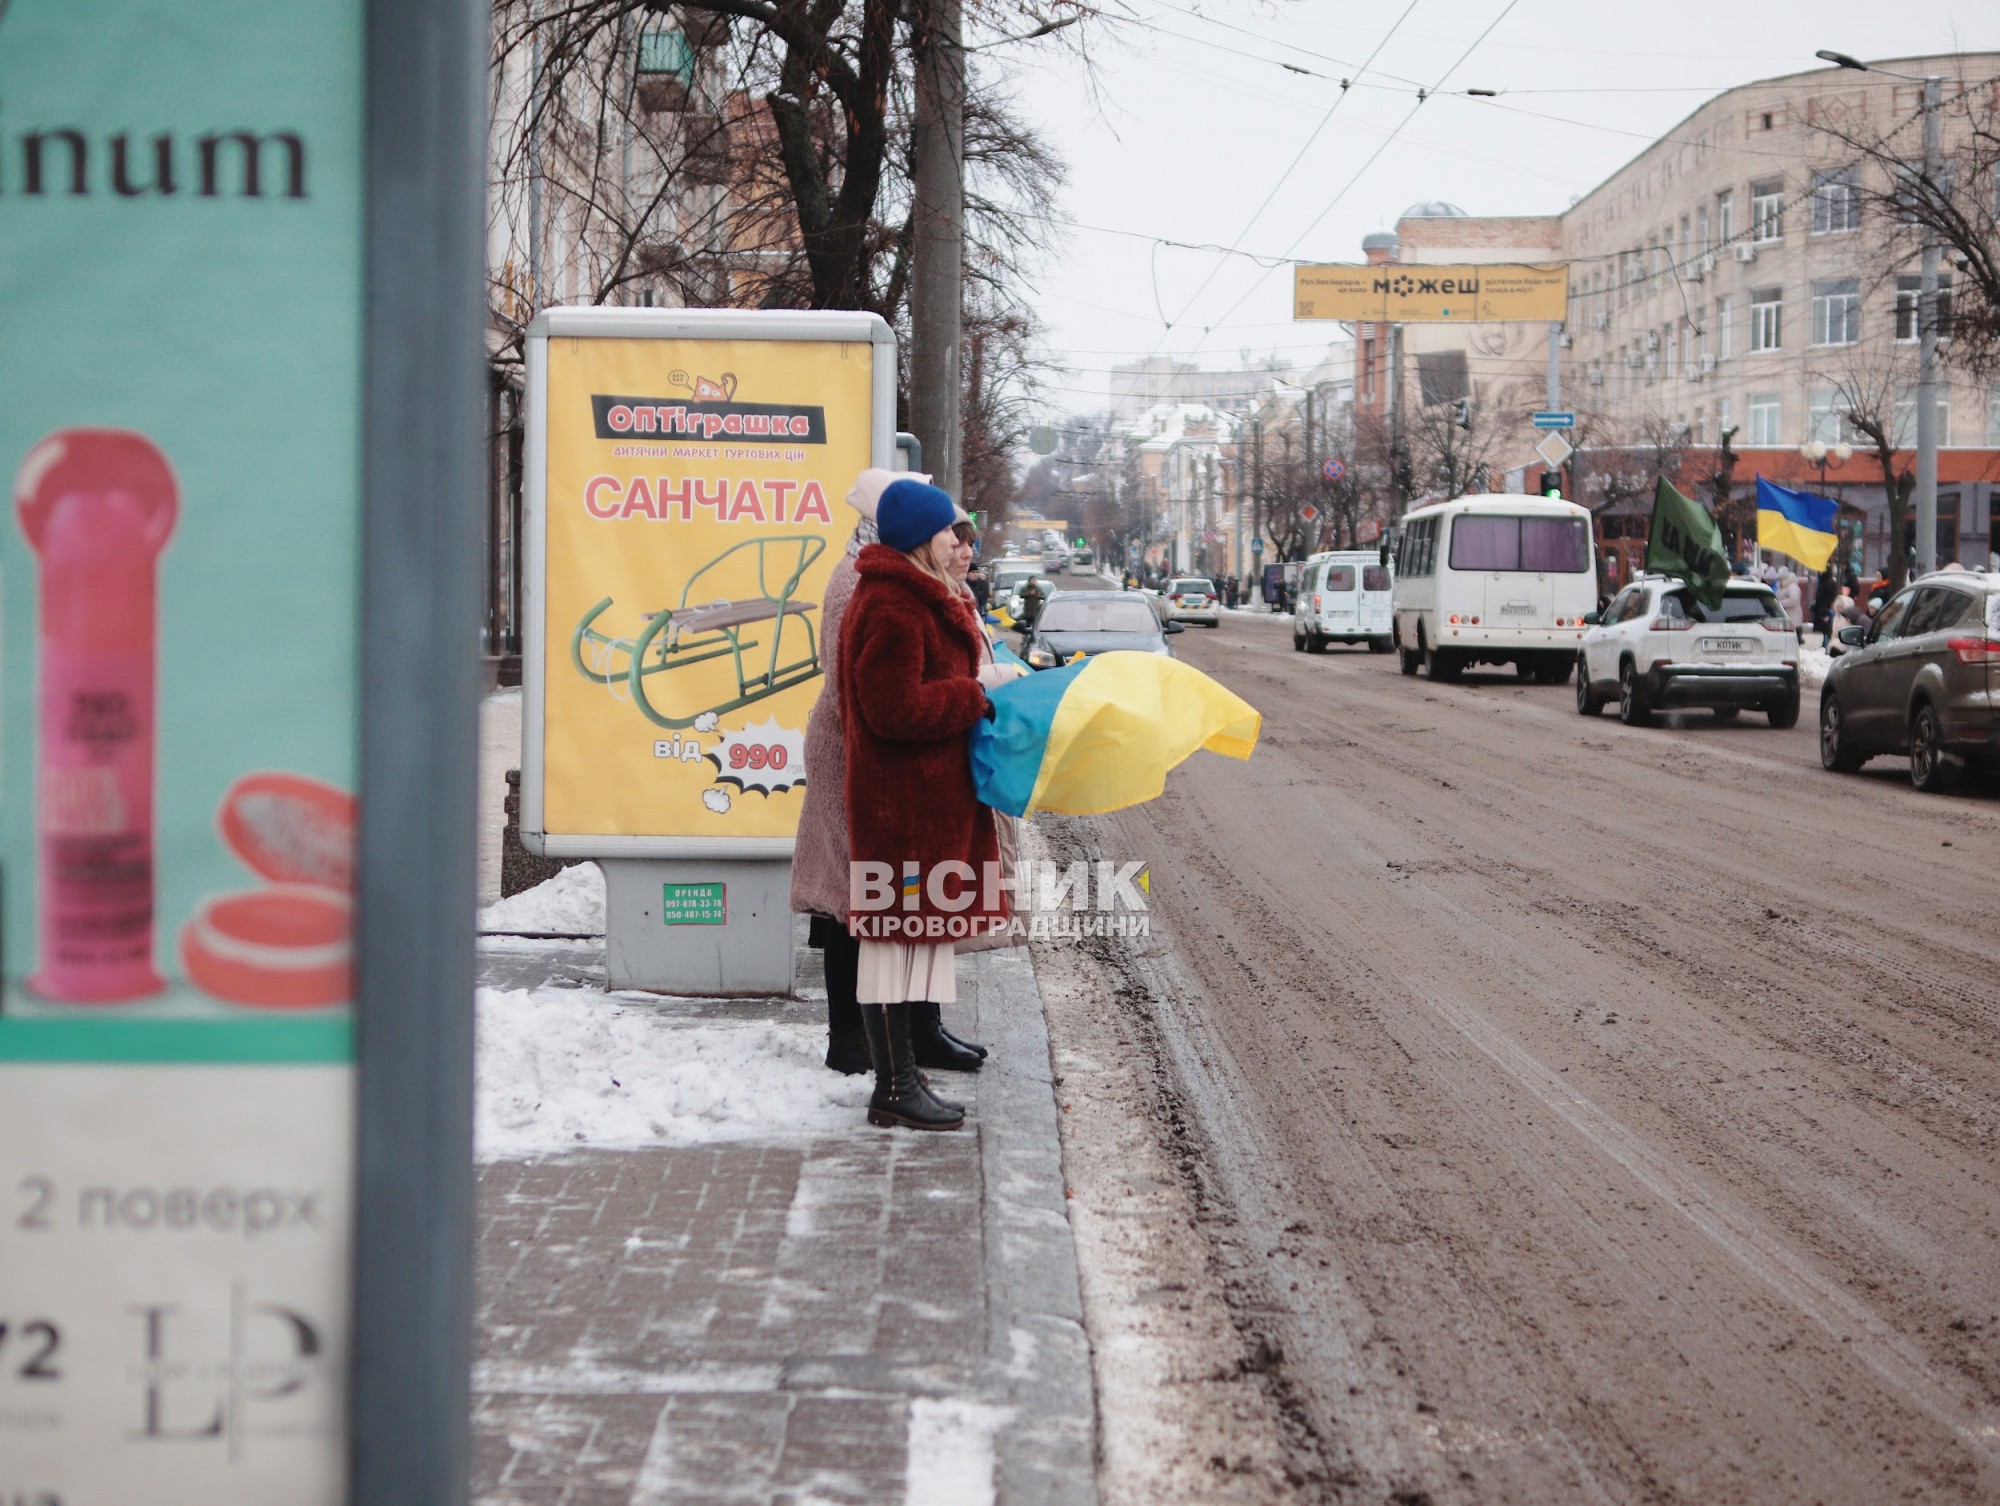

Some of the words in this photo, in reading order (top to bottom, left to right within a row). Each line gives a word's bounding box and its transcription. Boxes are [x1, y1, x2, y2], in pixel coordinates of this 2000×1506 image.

[614, 445, 668, 458] ДИТЯЧИЙ
[673, 448, 719, 459] МАРКЕТ
[725, 448, 781, 460] ГУРТОВИХ
[585, 475, 832, 524] САНЧАТА
[1716, 641, 1743, 650] КОТИК
[729, 743, 788, 771] 990
[675, 888, 713, 897] ОРЕНДА
[17, 1174, 55, 1231] 2
[78, 1185, 326, 1238] поверх
